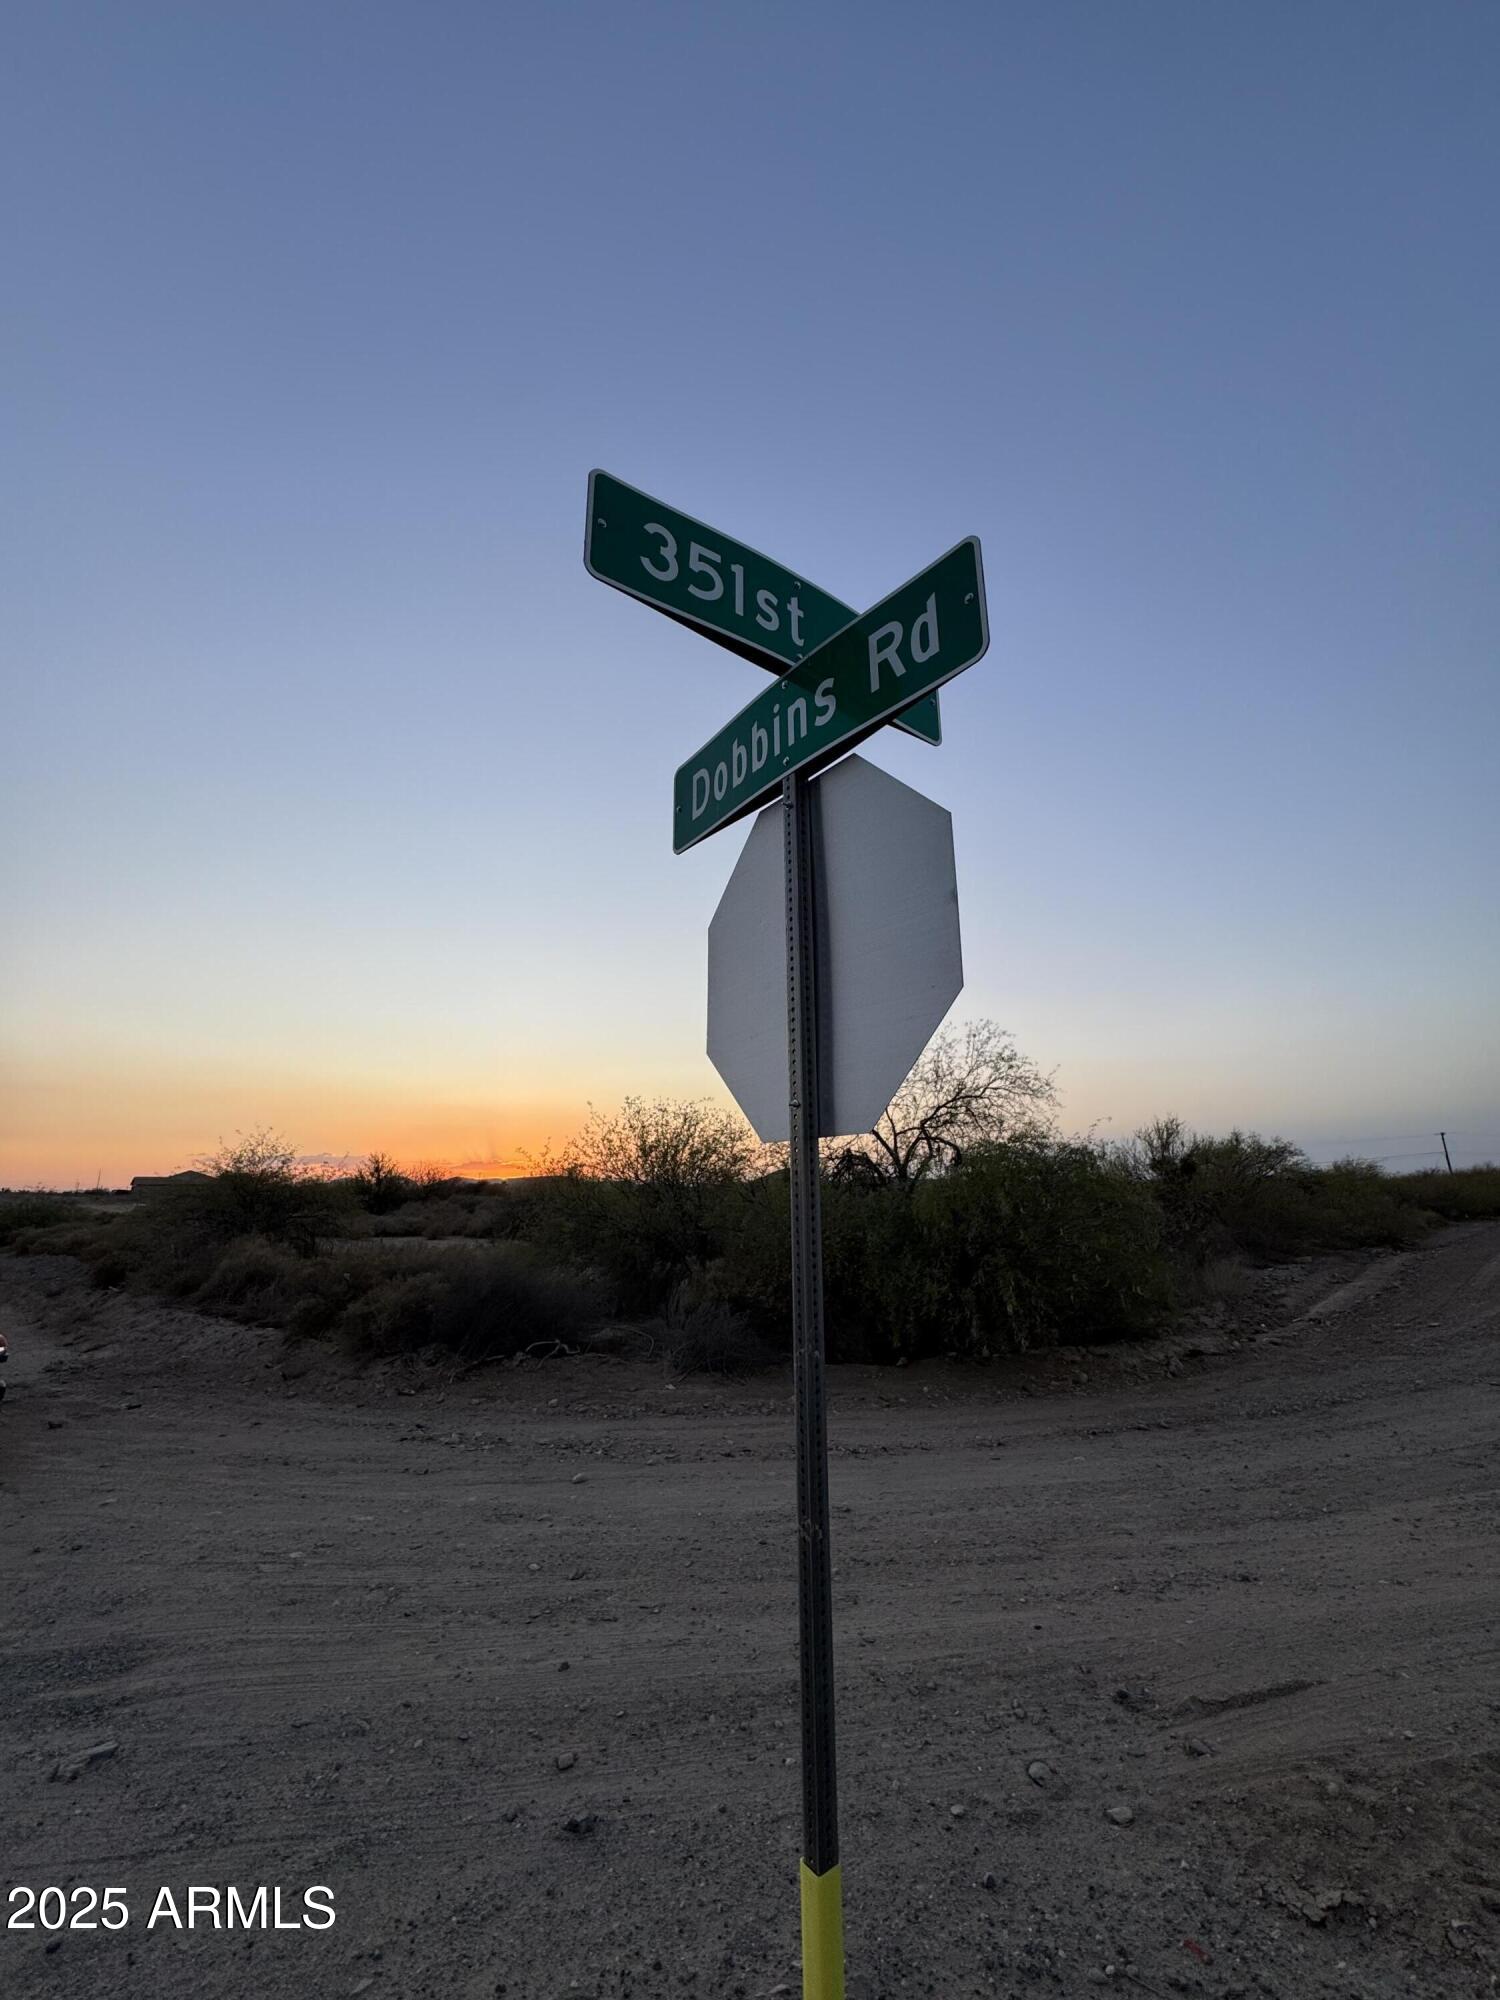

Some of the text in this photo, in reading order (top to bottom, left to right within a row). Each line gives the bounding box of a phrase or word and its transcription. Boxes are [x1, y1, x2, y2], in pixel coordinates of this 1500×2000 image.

[640, 522, 804, 646] 351st
[691, 592, 940, 821] Dobbins Rd
